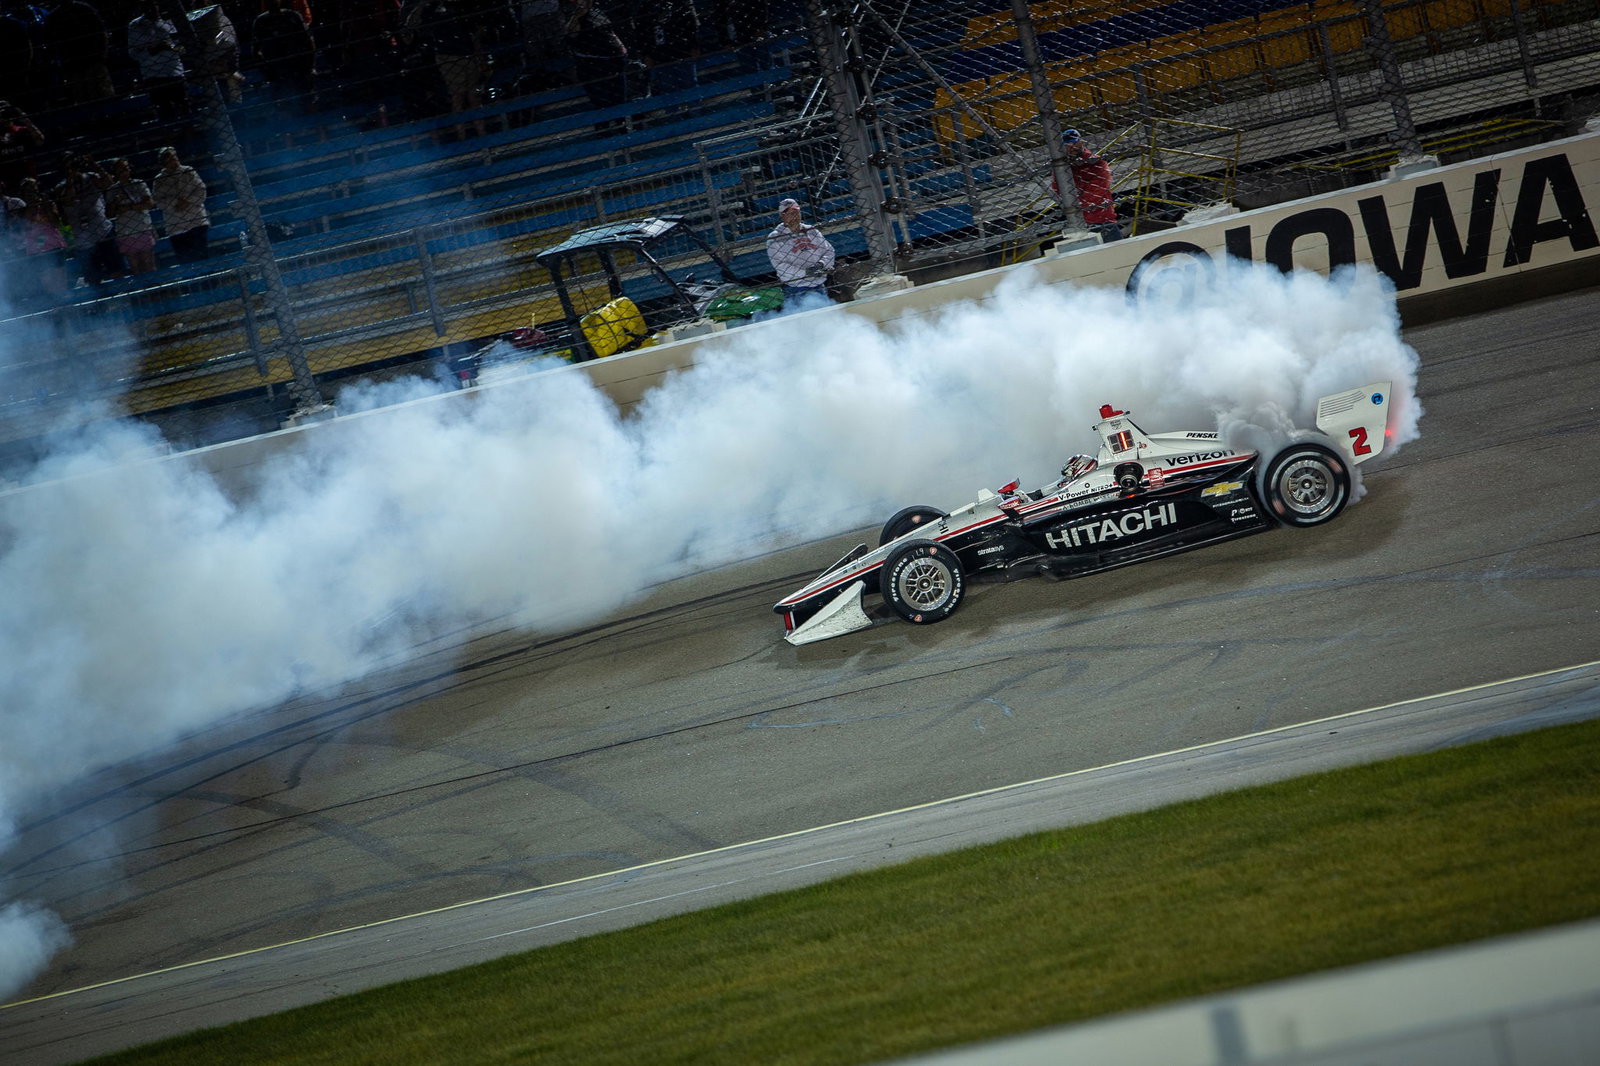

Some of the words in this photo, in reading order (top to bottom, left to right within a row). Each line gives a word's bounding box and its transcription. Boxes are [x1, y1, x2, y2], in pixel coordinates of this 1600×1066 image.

[1348, 426, 1372, 457] 2
[1166, 449, 1235, 467] verizon
[1059, 488, 1089, 501] V-Power
[1045, 502, 1177, 549] HITACHI
